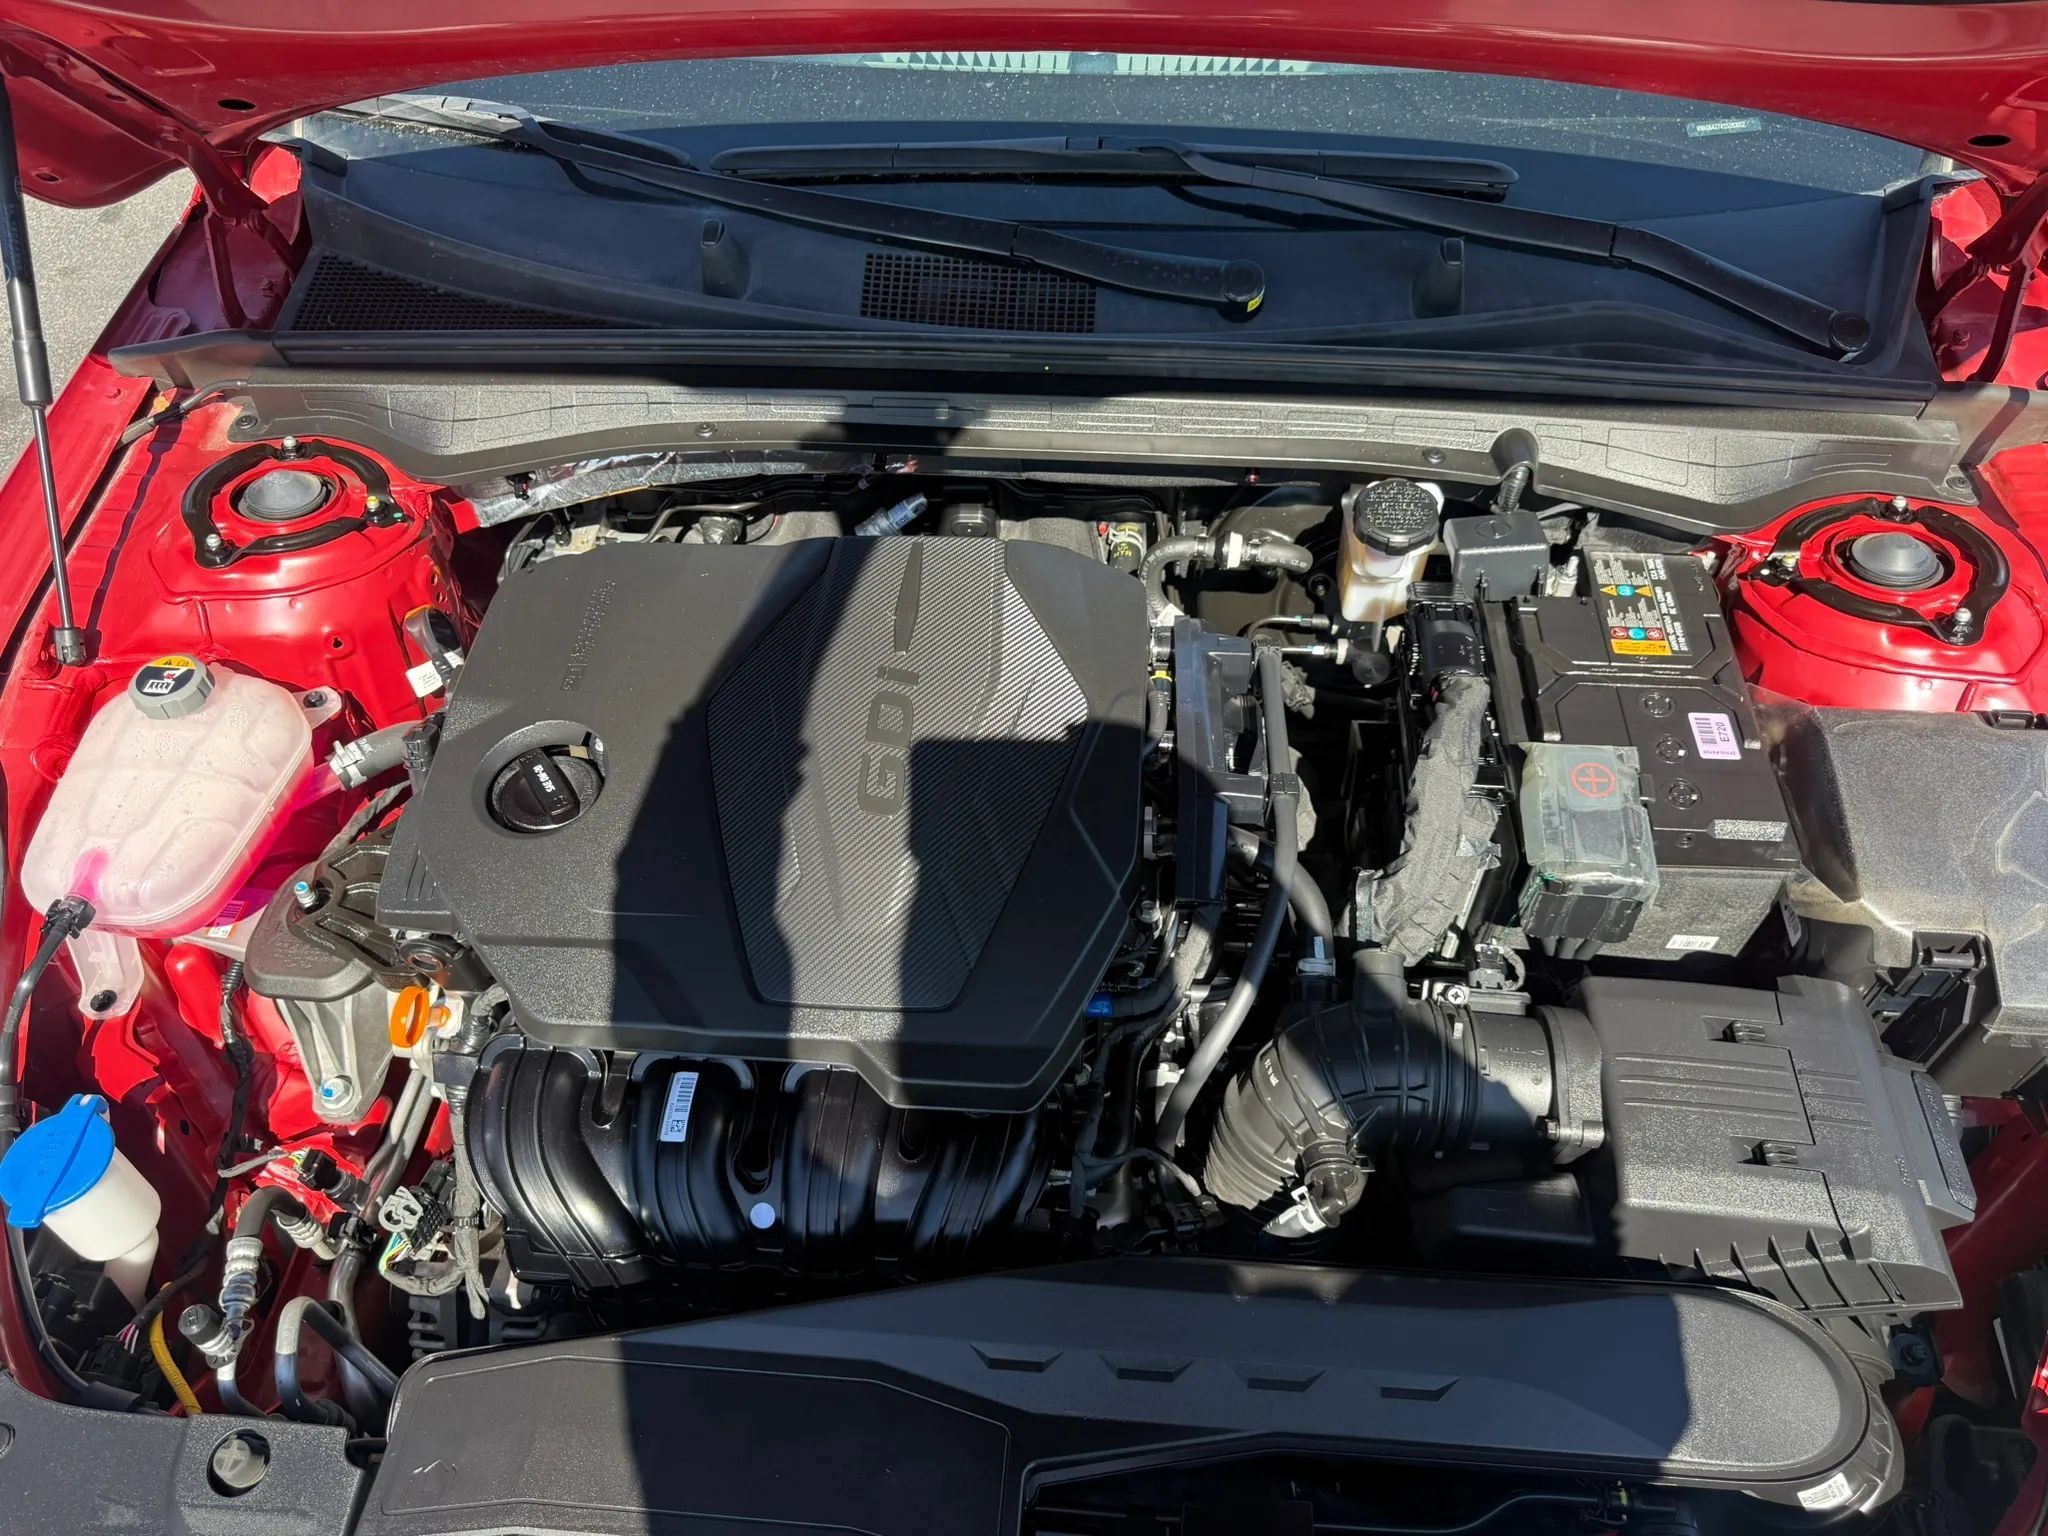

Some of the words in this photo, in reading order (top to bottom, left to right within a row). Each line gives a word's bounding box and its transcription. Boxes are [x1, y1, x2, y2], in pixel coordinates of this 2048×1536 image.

[857, 666, 920, 818] GDI
[1715, 721, 1730, 743] E720
[541, 775, 555, 793] SAE
